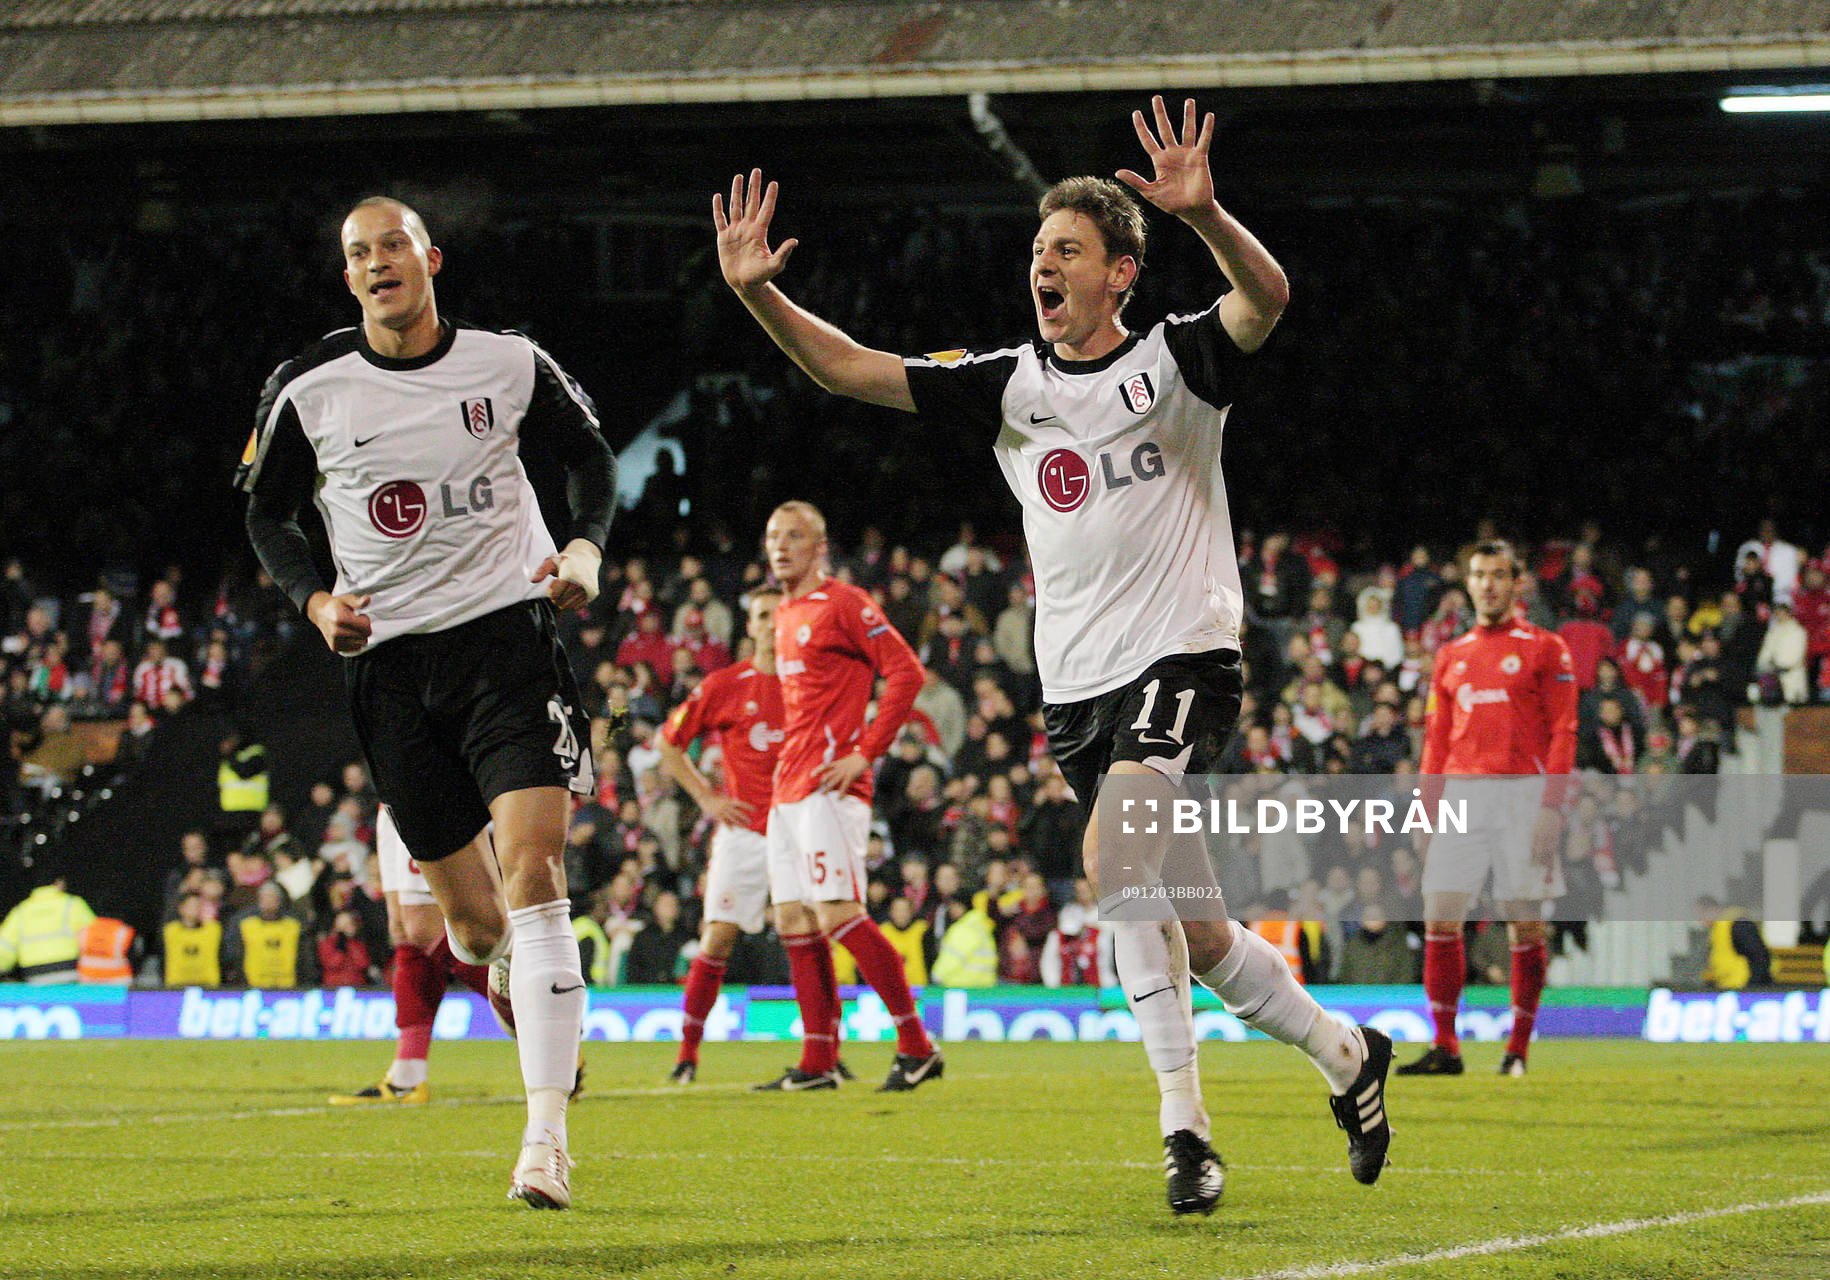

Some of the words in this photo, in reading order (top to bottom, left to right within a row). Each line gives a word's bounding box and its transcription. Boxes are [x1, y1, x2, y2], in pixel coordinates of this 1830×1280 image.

[1100, 442, 1166, 490] LG
[441, 475, 494, 518] LG
[1130, 678, 1196, 746] 11
[178, 986, 472, 1039] bet-at-hoe
